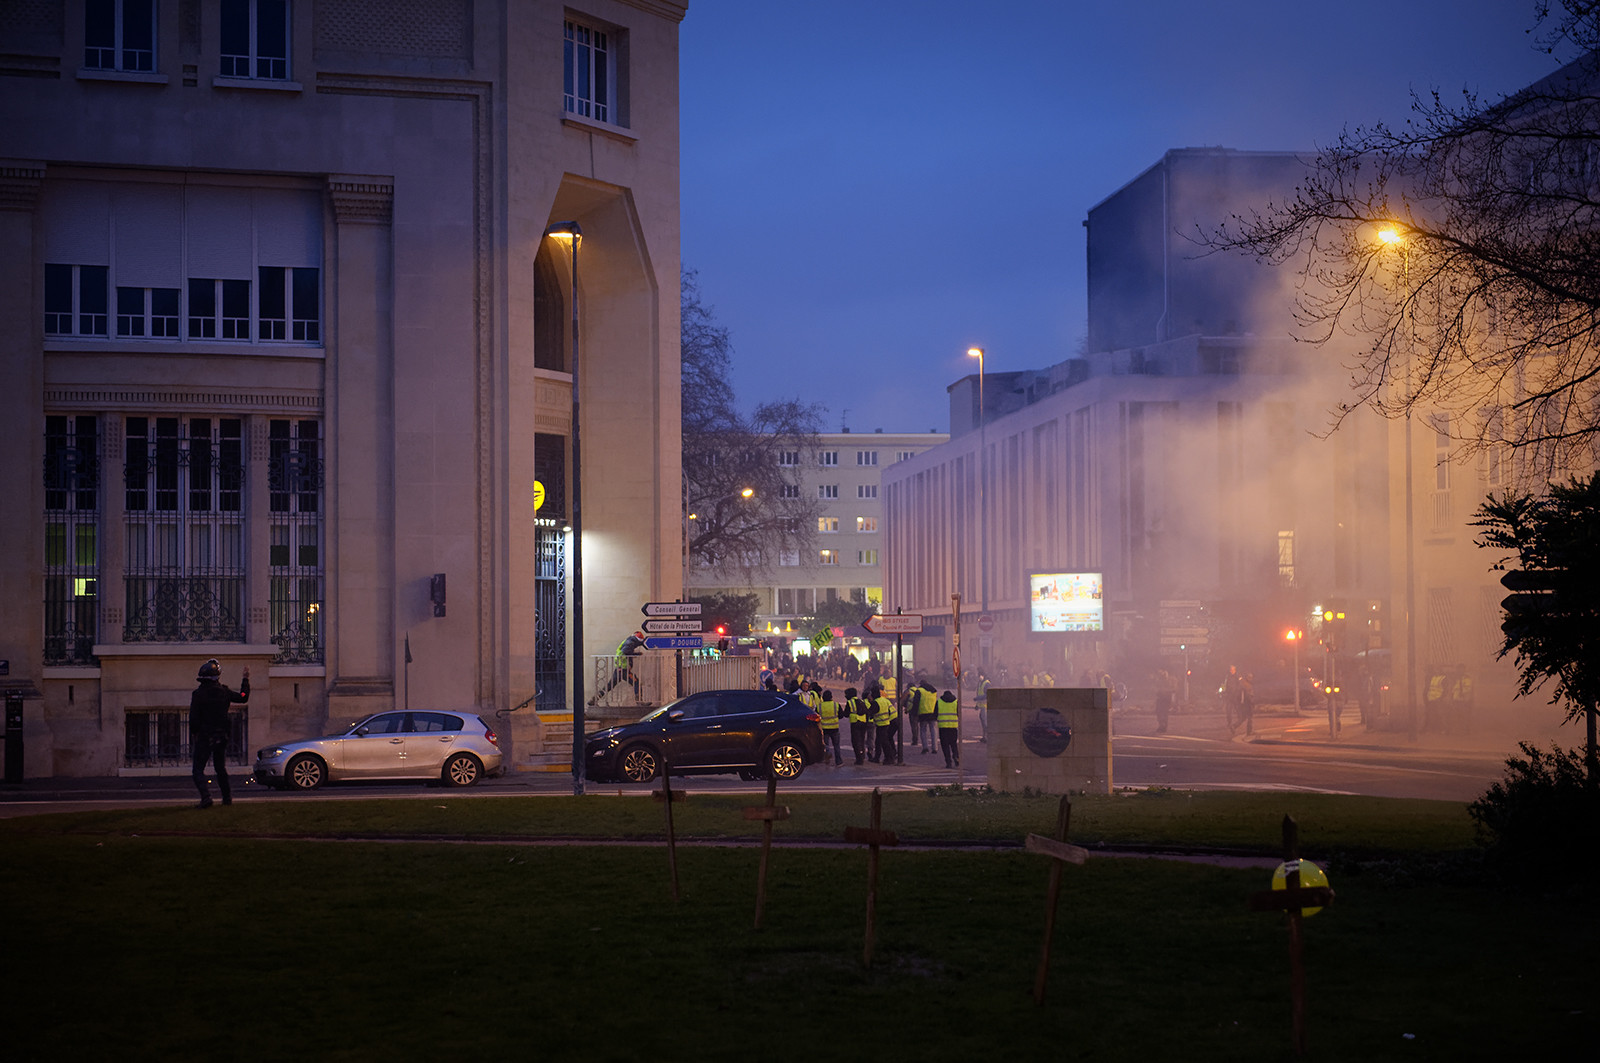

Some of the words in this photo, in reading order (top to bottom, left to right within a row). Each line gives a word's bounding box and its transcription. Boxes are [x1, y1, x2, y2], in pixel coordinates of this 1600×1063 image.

[655, 605, 677, 613] Conseil
[679, 605, 700, 613] Général
[650, 622, 663, 630] Hôtel
[664, 622, 670, 630] de
[670, 622, 675, 630] la
[676, 622, 700, 630] Préfecture
[815, 627, 834, 647] RIC
